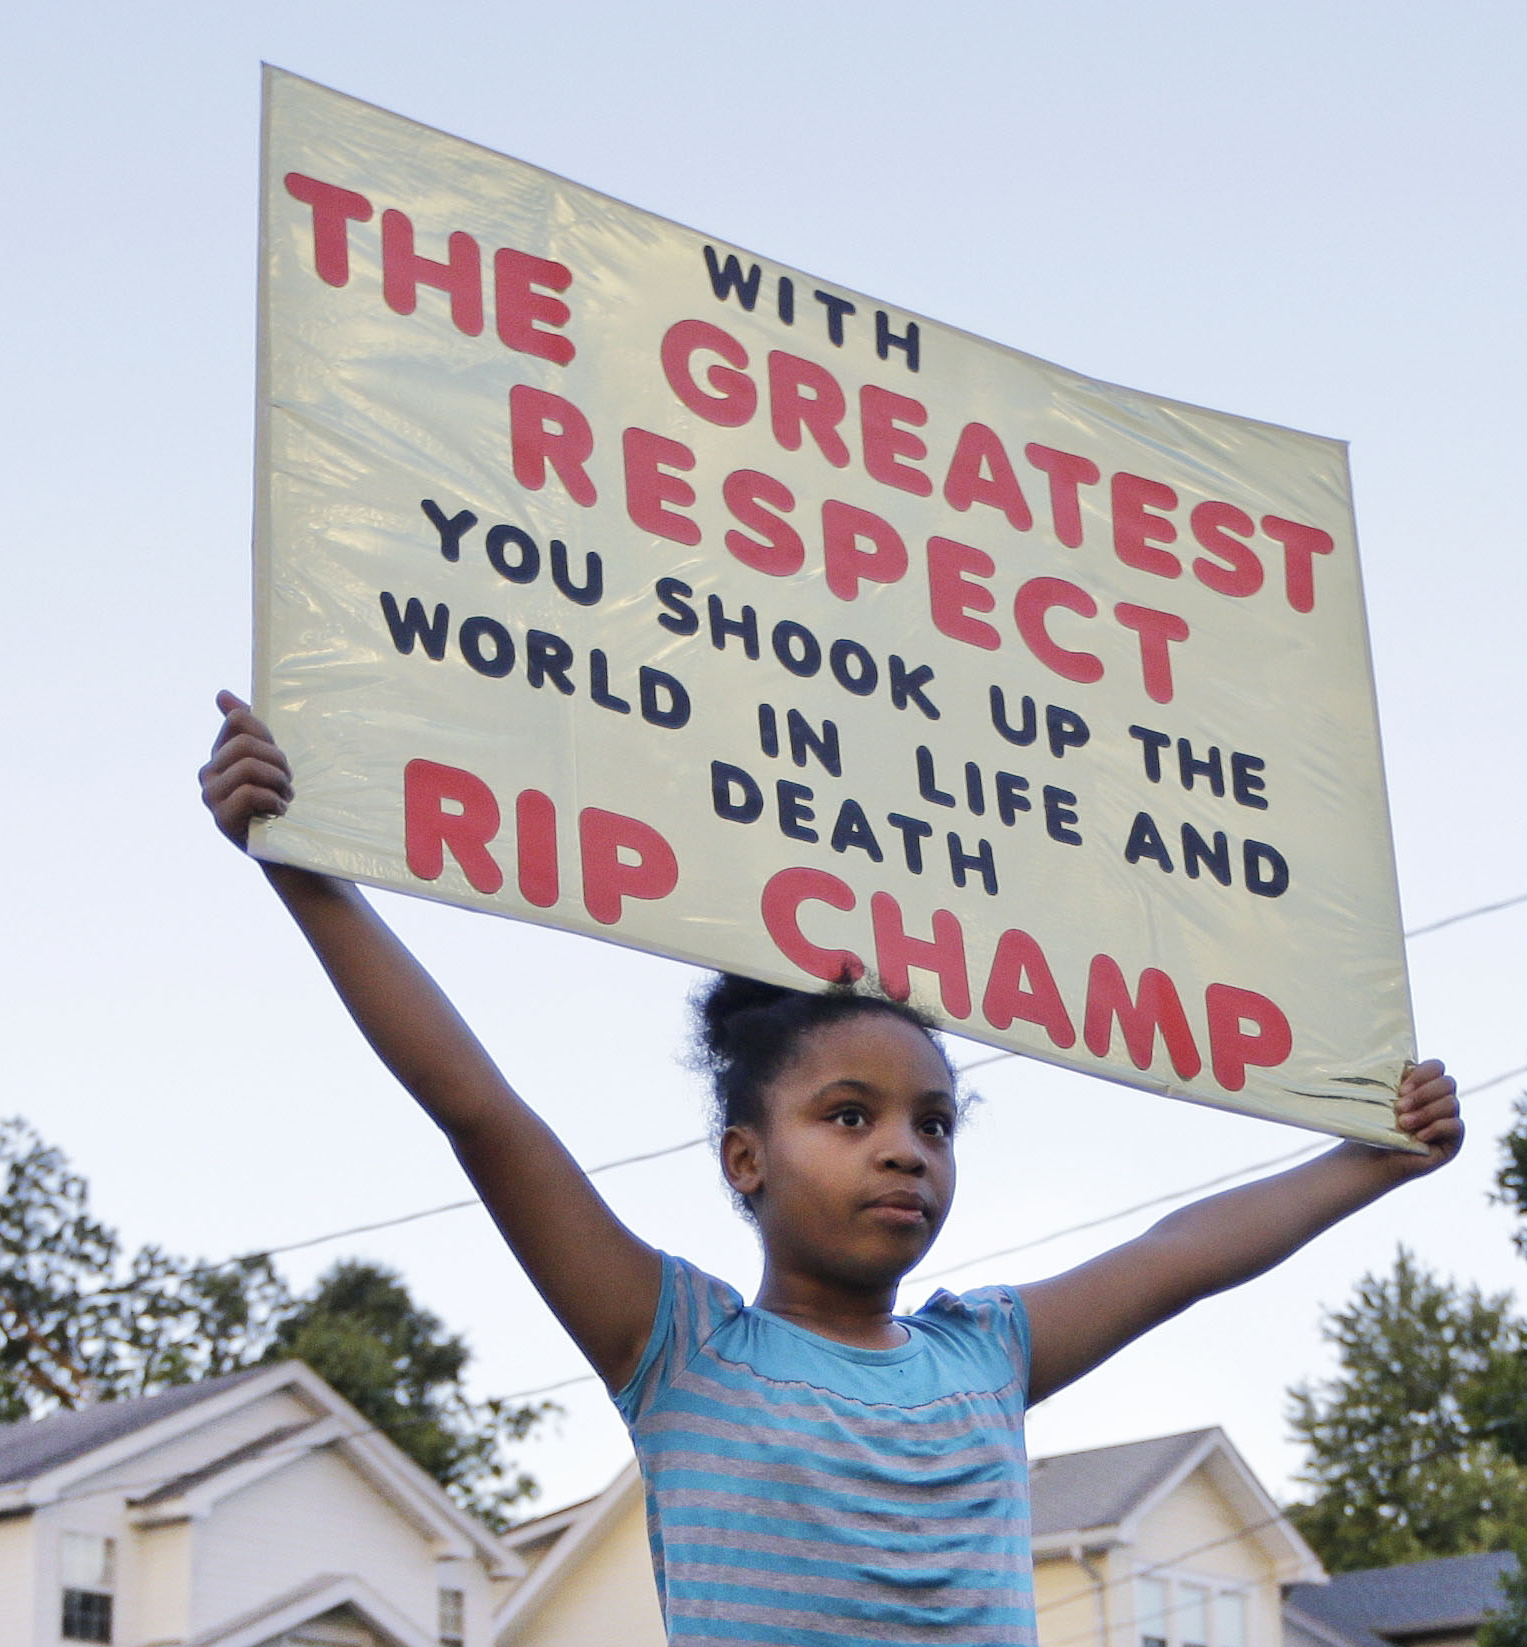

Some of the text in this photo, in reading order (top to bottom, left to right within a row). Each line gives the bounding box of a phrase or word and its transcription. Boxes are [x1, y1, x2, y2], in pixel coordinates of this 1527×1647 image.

[285, 171, 1335, 615] THE GREATEST
[702, 244, 922, 373] WITH
[419, 498, 1270, 811] YOU SHOOK UP THE
[509, 383, 1191, 705] RESPECT
[378, 590, 1291, 900] WORLD IN LIFE AND
[709, 759, 1000, 897] DEATH
[403, 757, 1293, 1092] RIP CHAMP
